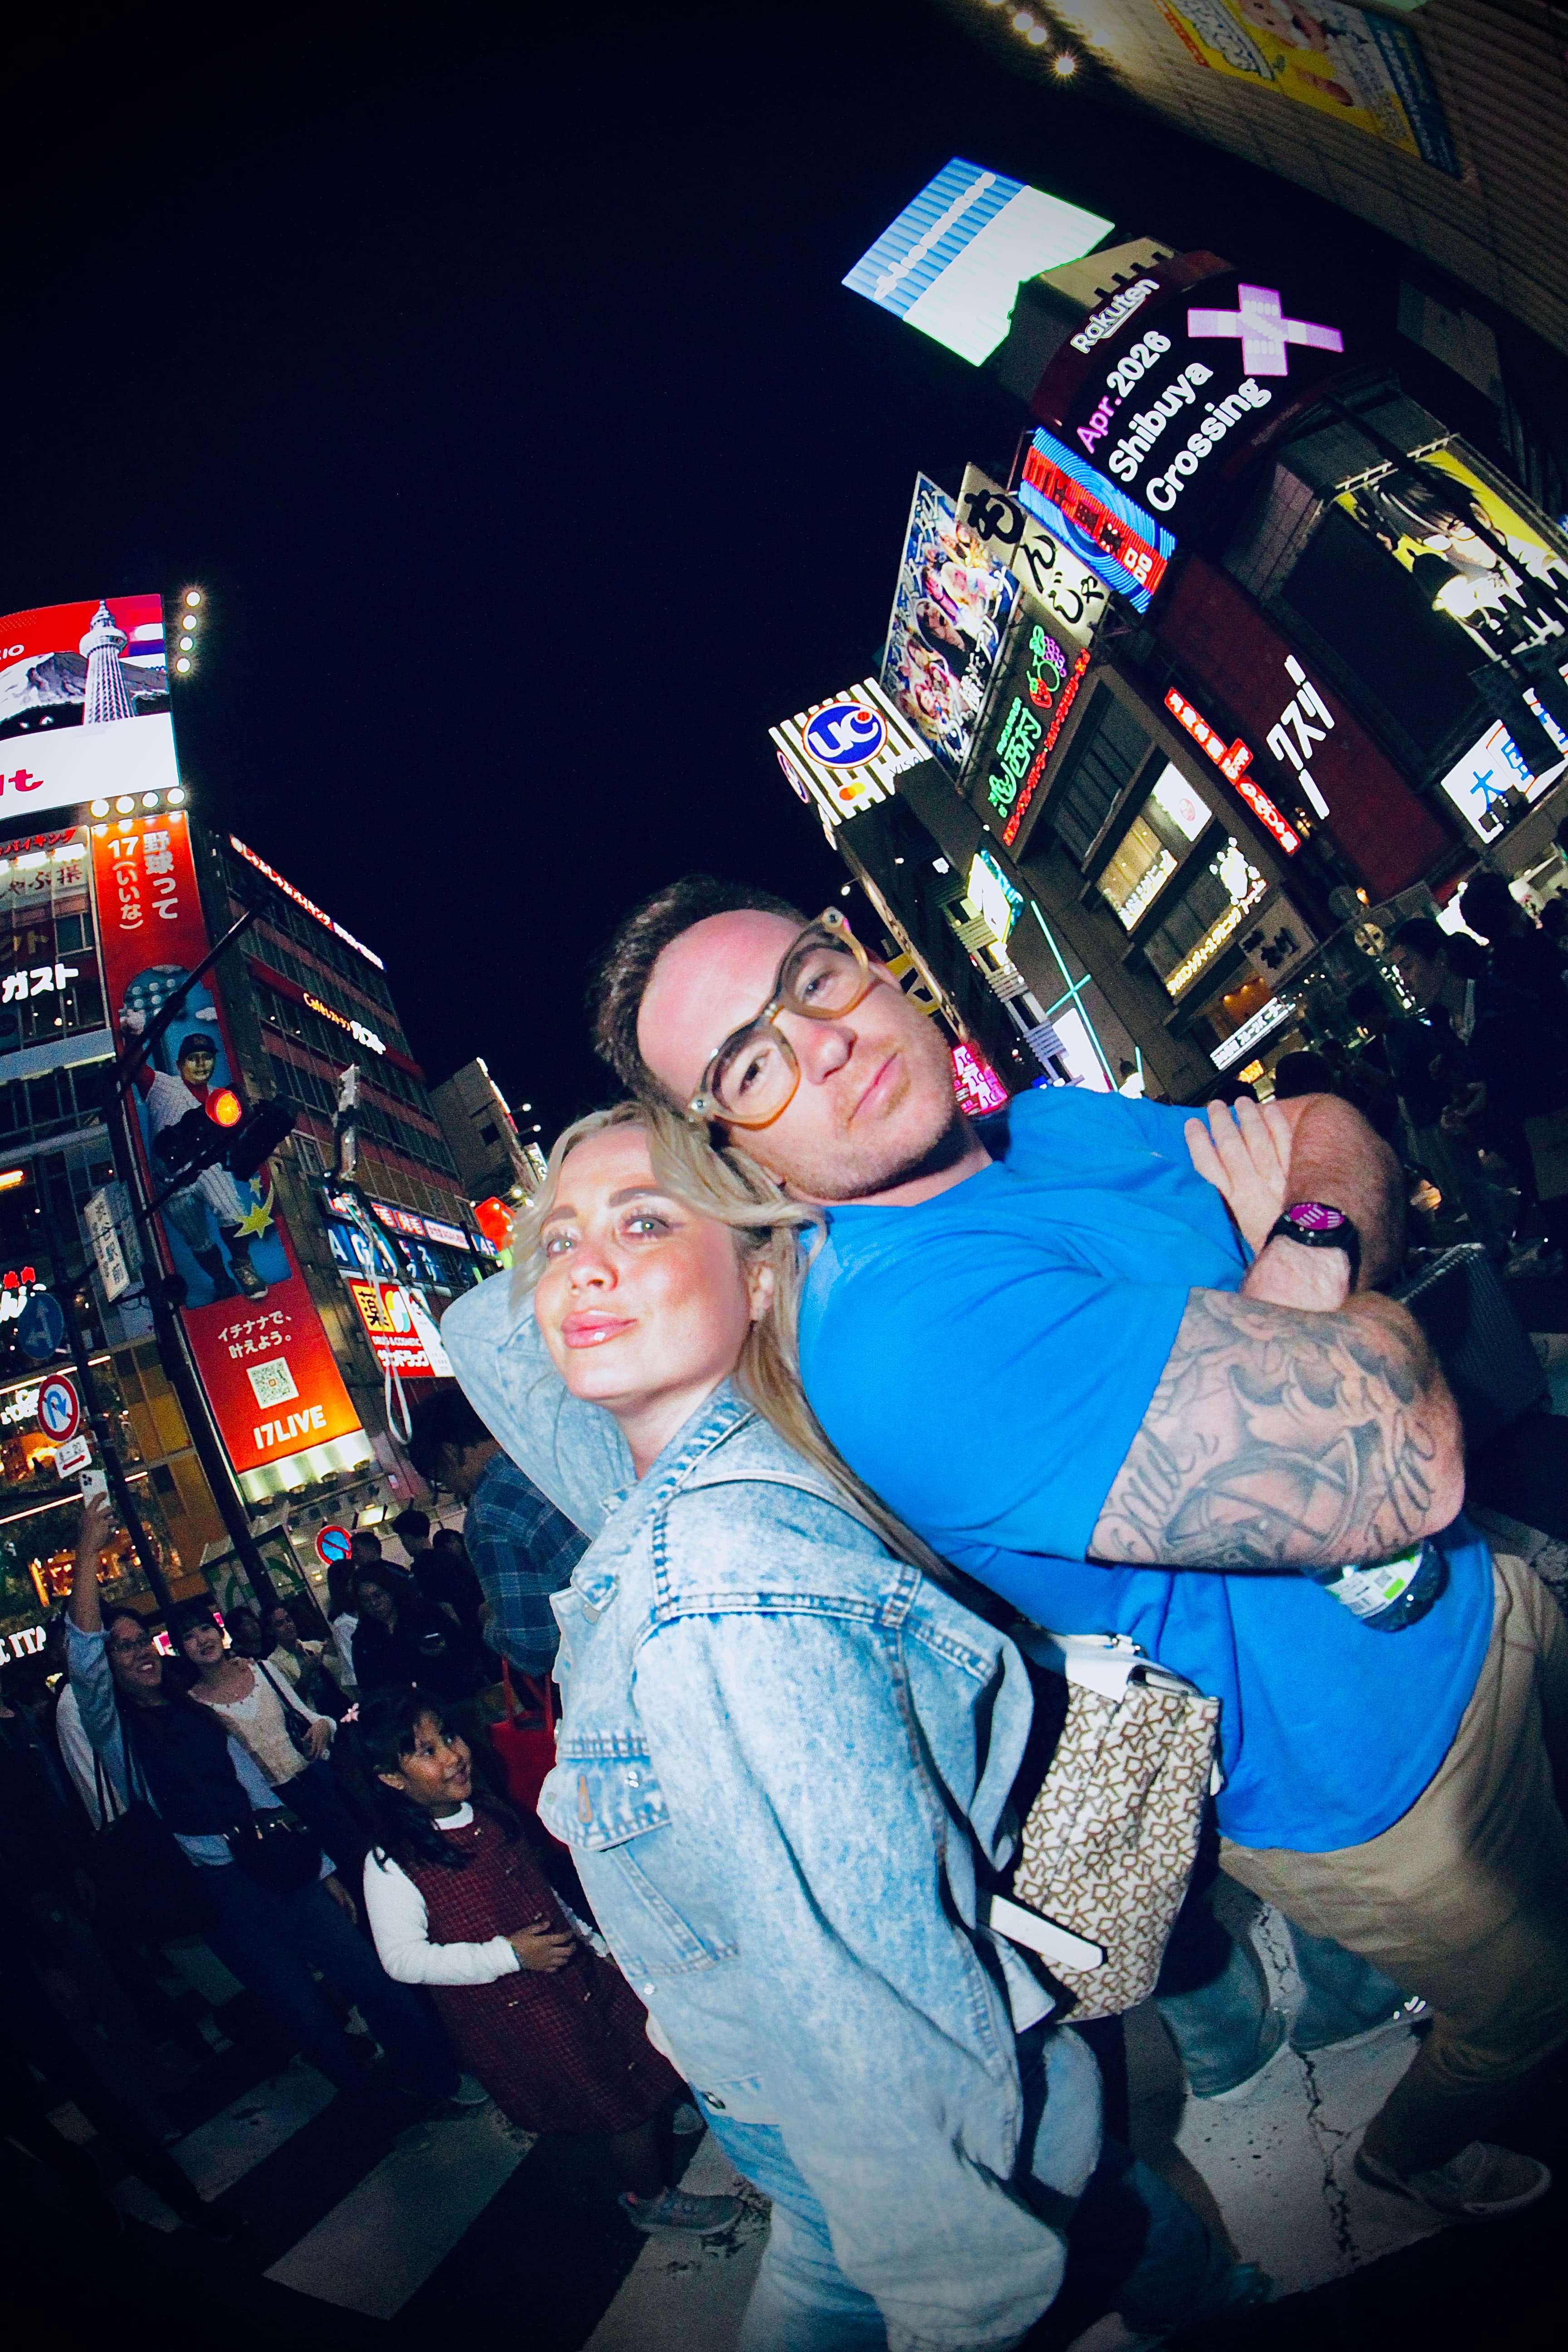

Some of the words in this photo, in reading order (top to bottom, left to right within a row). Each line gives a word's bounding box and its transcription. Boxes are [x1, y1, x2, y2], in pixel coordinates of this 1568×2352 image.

[1070, 279, 1160, 353] Rakuten
[1108, 363, 1214, 482] Shibuya
[1146, 377, 1272, 511] Crossing
[964, 489, 1105, 625] もんじゃ
[808, 712, 878, 757] UC
[1004, 707, 1042, 777] 西村
[889, 756, 923, 775] VISA
[0, 828, 76, 856] バイキング
[0, 859, 83, 899] ゃぶ葉
[142, 831, 178, 920] 野球って
[2, 963, 78, 1001] ガスト
[217, 1310, 292, 1344] イチナナで、
[358, 1290, 389, 1327] 薬
[228, 1331, 292, 1360] 叶えよう。
[377, 1349, 430, 1367] サンドラッグ
[253, 1405, 326, 1450] 17LIVE
